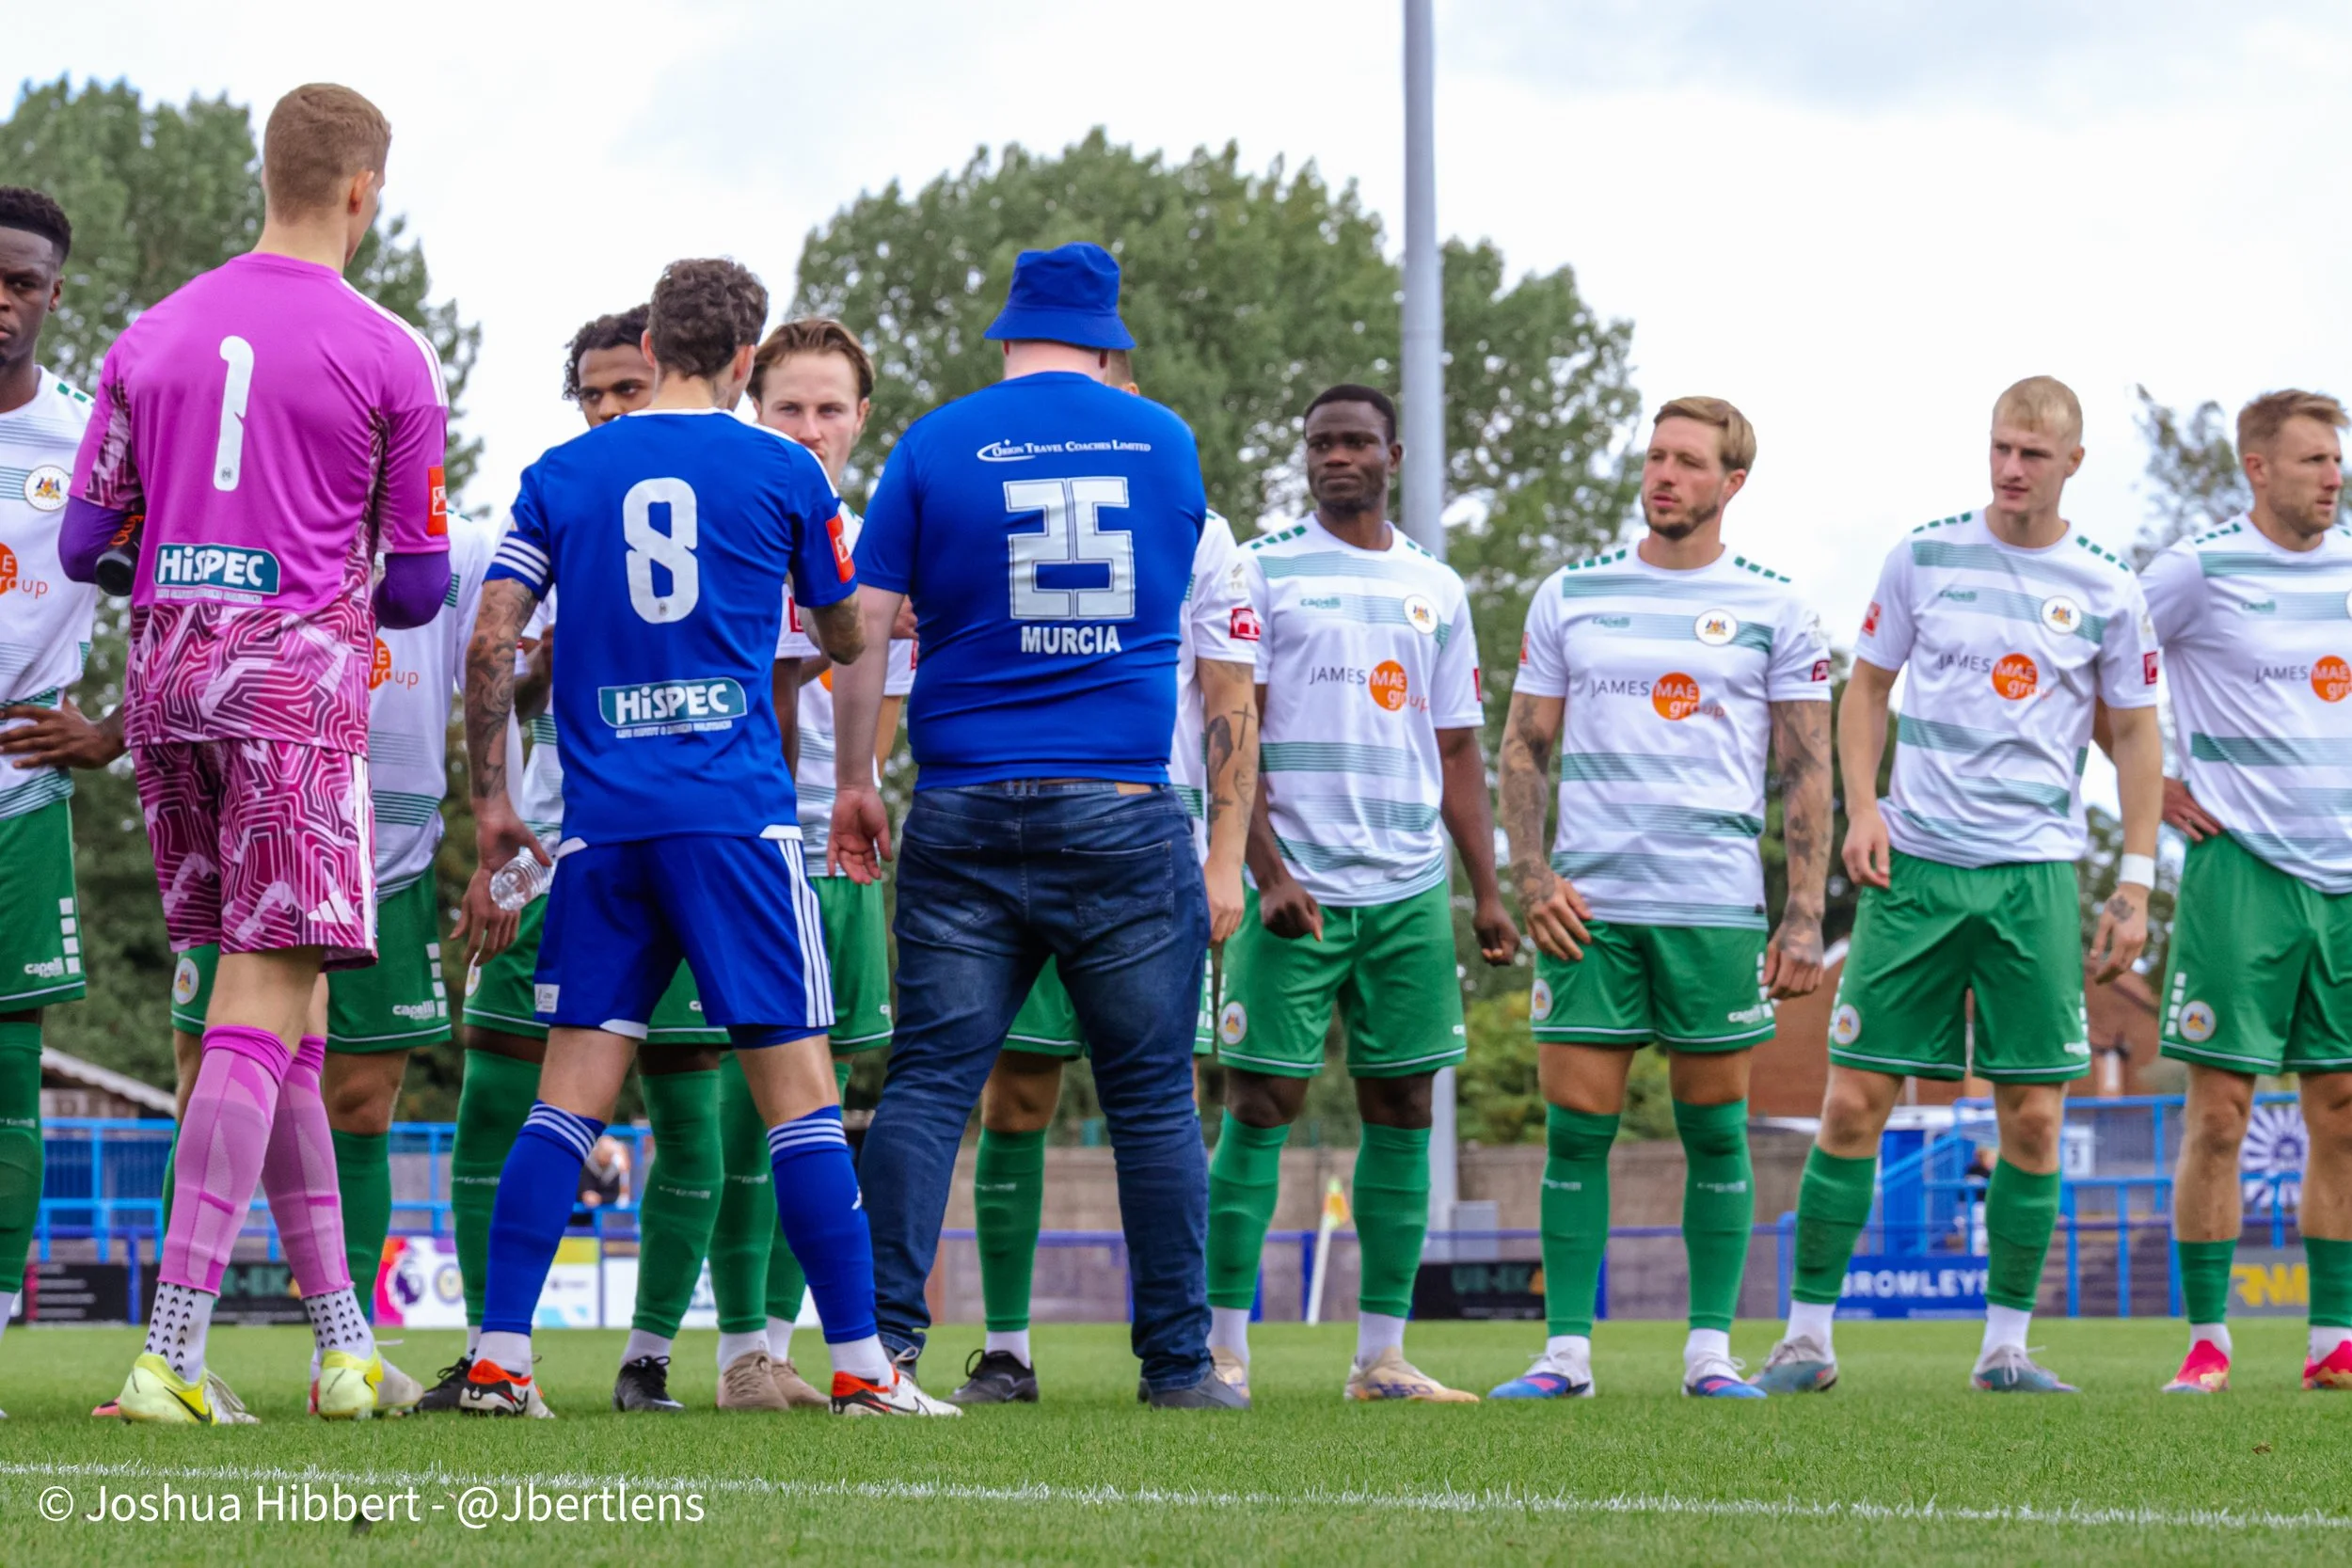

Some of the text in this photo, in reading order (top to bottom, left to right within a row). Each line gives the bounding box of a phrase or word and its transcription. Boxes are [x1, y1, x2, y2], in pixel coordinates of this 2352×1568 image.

[214, 336, 254, 491] 1
[623, 477, 699, 624] 8
[1003, 476, 1136, 621] 25
[0, 575, 49, 599] roup
[1021, 626, 1121, 655] MURCIA
[372, 668, 420, 690] roup
[1309, 666, 1405, 689] JAMES MAE
[2254, 665, 2309, 684] JAMES
[1591, 677, 1697, 700] JAMES MAE
